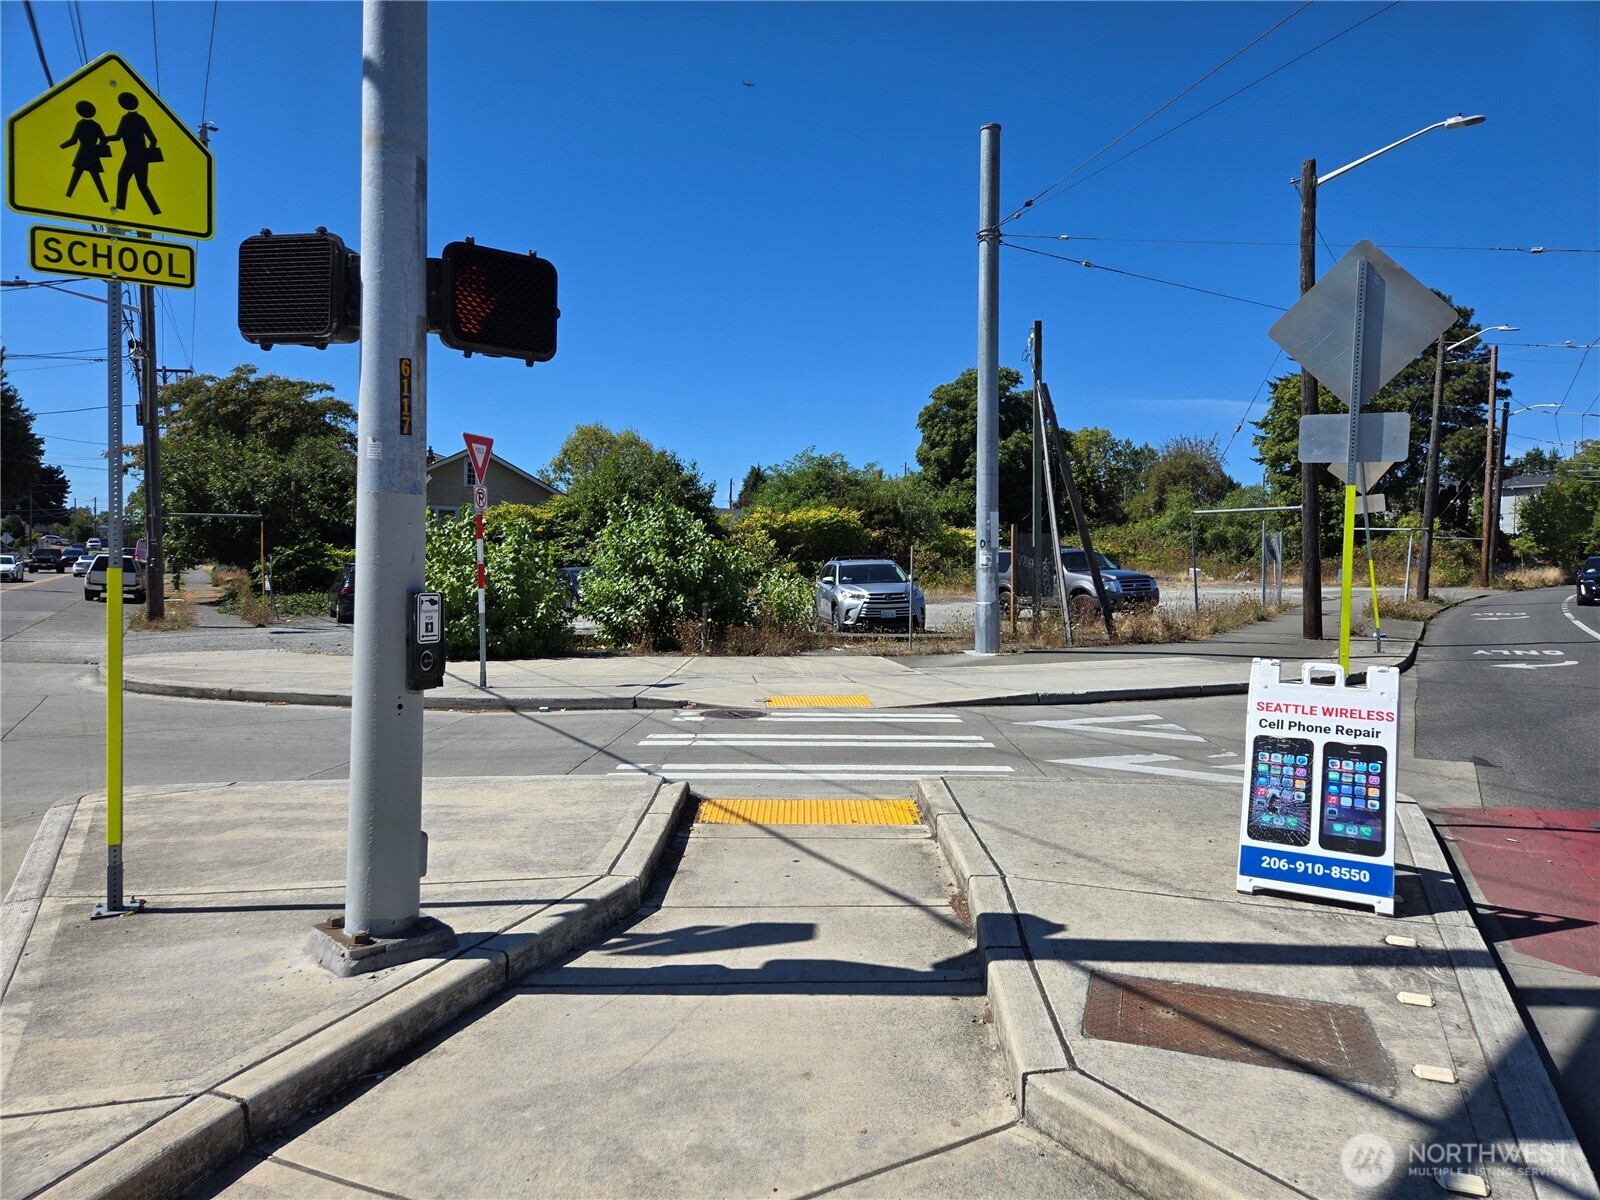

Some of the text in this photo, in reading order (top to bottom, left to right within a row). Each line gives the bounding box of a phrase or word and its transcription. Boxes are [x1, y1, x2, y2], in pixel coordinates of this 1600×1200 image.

[43, 237, 186, 279] SCHOOL
[401, 358, 411, 434] 6117
[1256, 702, 1395, 722] SEATTLE WIRELESS
[1258, 718, 1382, 740] Cell Phone Repair
[1261, 856, 1370, 882] 206-910-8550
